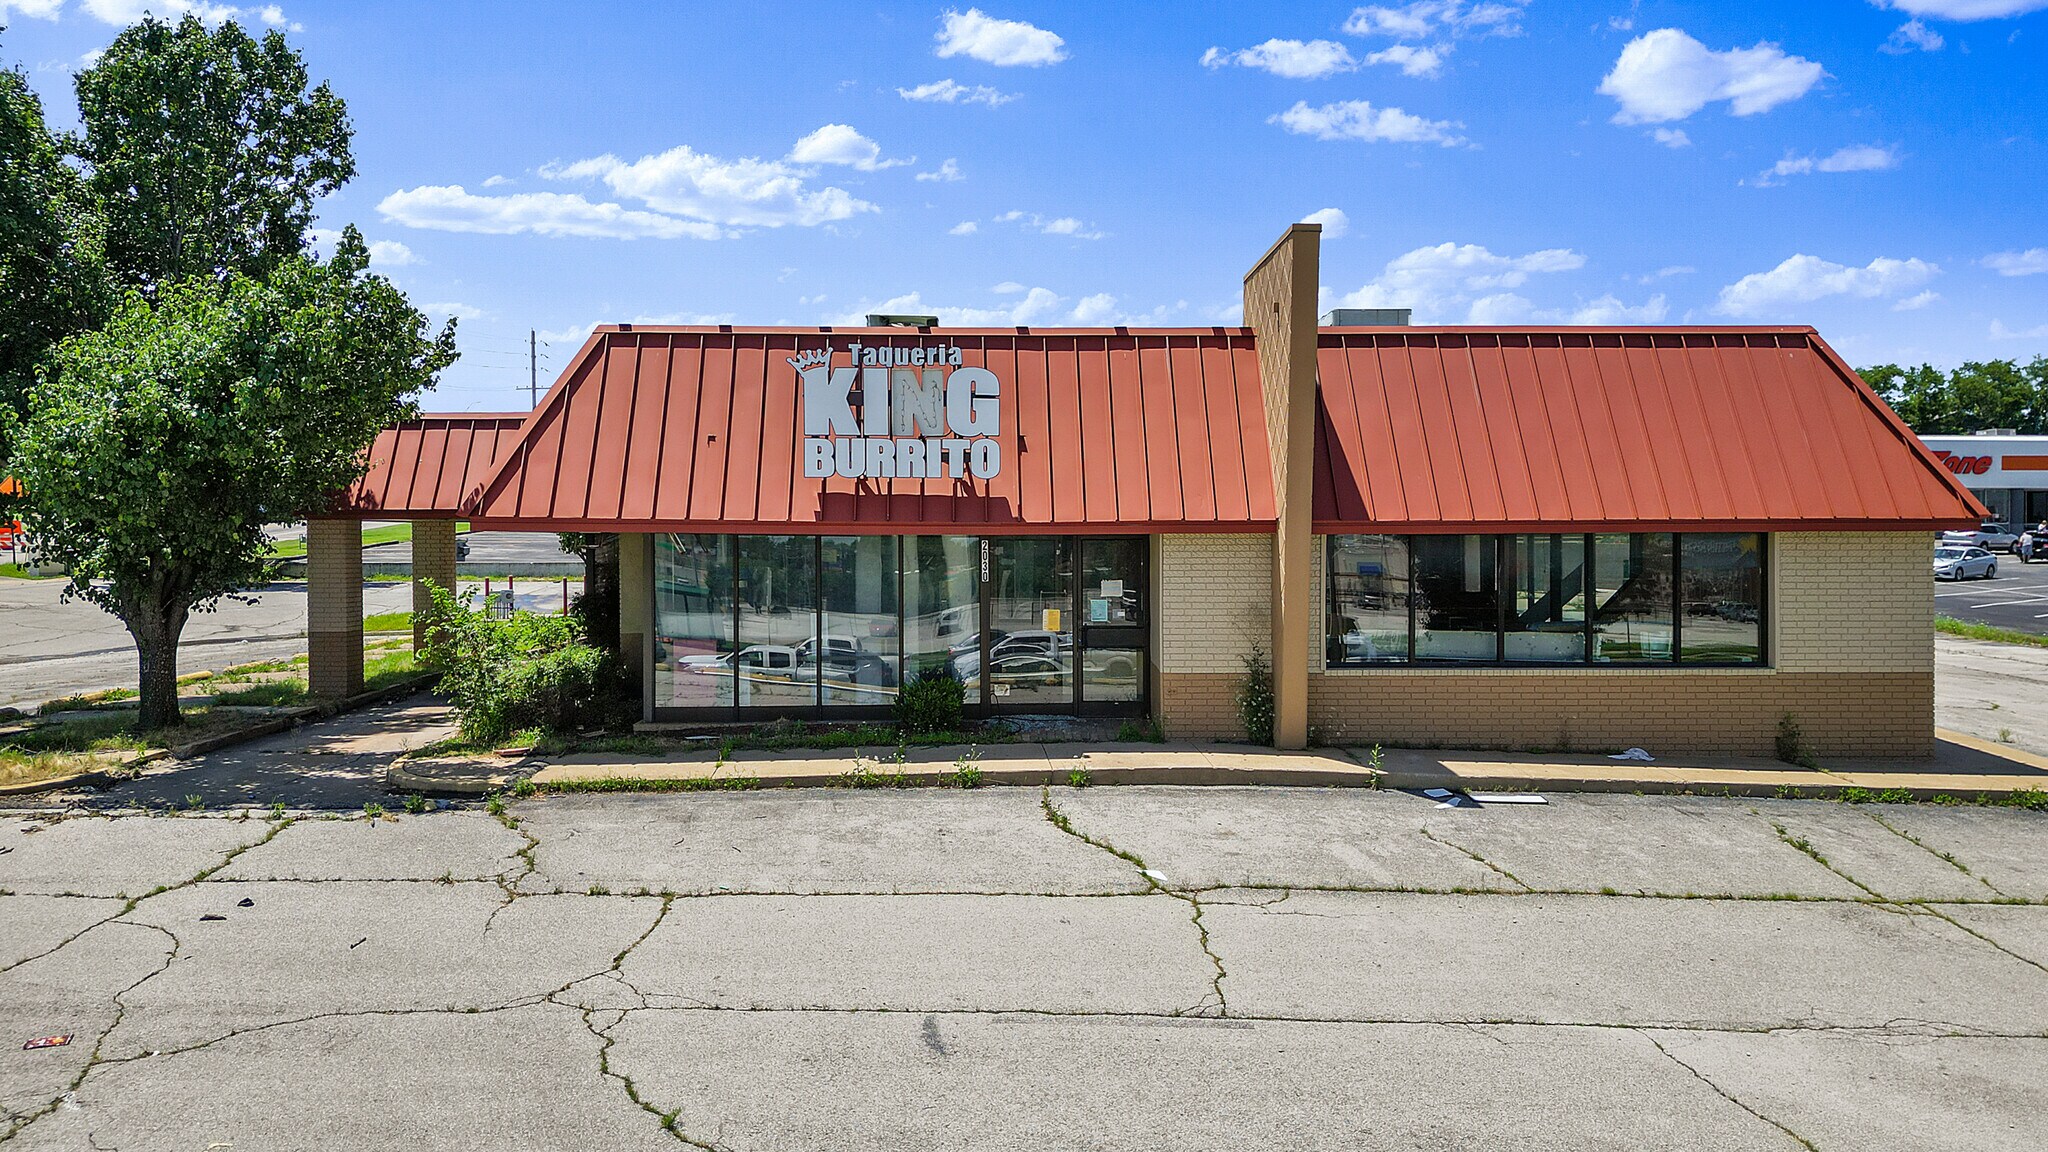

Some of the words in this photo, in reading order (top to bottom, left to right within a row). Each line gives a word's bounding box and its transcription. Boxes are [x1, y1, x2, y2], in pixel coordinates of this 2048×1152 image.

[848, 343, 963, 367] Taqueria
[803, 366, 1000, 437] KING
[803, 438, 1001, 479] BURRITO
